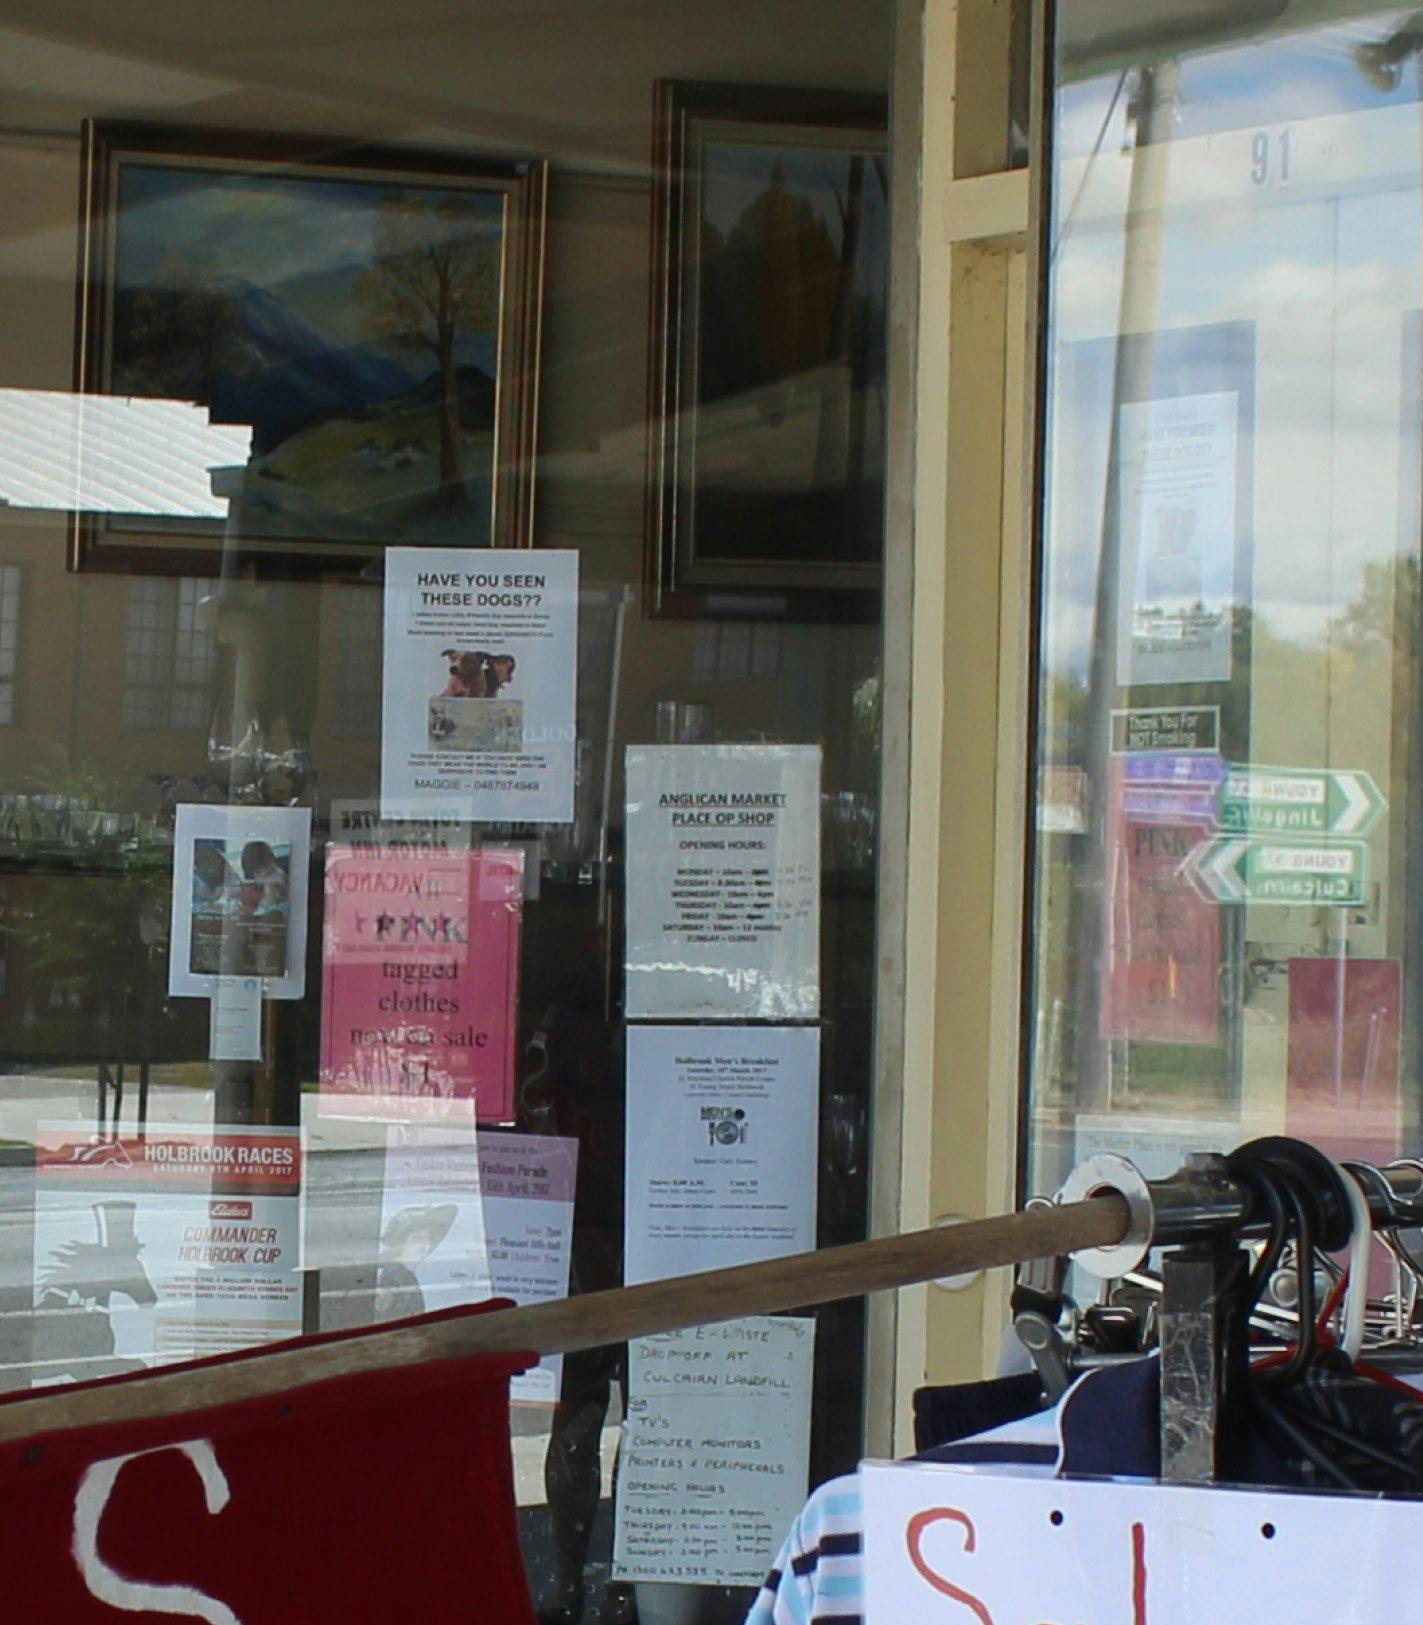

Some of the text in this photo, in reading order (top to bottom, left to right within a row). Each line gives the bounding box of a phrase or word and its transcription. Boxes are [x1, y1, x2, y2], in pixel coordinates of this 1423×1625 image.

[1251, 126, 1291, 186] 91
[417, 573, 547, 588] HAVE YOU SEEN
[421, 592, 543, 607] THESE DOGS??
[414, 778, 462, 791] MAGGIE
[659, 793, 787, 806] ANGLICAN MARKET
[672, 812, 775, 826] PLACE OP SHOP
[679, 841, 725, 850] OPENING
[376, 914, 470, 944] PINK
[381, 959, 459, 985] tagged
[378, 990, 461, 1015] clothes
[350, 1026, 489, 1048] now on sale
[144, 1144, 294, 1165] HOLBROOK RACES
[152, 1163, 207, 1173] SATURDAY
[234, 1165, 264, 1175] APRIL
[268, 1166, 292, 1175] 2017
[482, 1161, 516, 1175] Fashion
[517, 1164, 549, 1177] Parade
[184, 1226, 278, 1244] COMMANDER
[178, 1245, 282, 1264] HOLBROOK CUP
[726, 1350, 753, 1362] AT
[643, 1371, 791, 1388] CULCAIRN LANDFILL
[632, 1435, 762, 1450] COMPUTER MONITORS
[628, 1454, 683, 1469] PRINTERS
[704, 1459, 785, 1475] PERIPHERALS
[626, 1481, 725, 1494] OPENING HOURS
